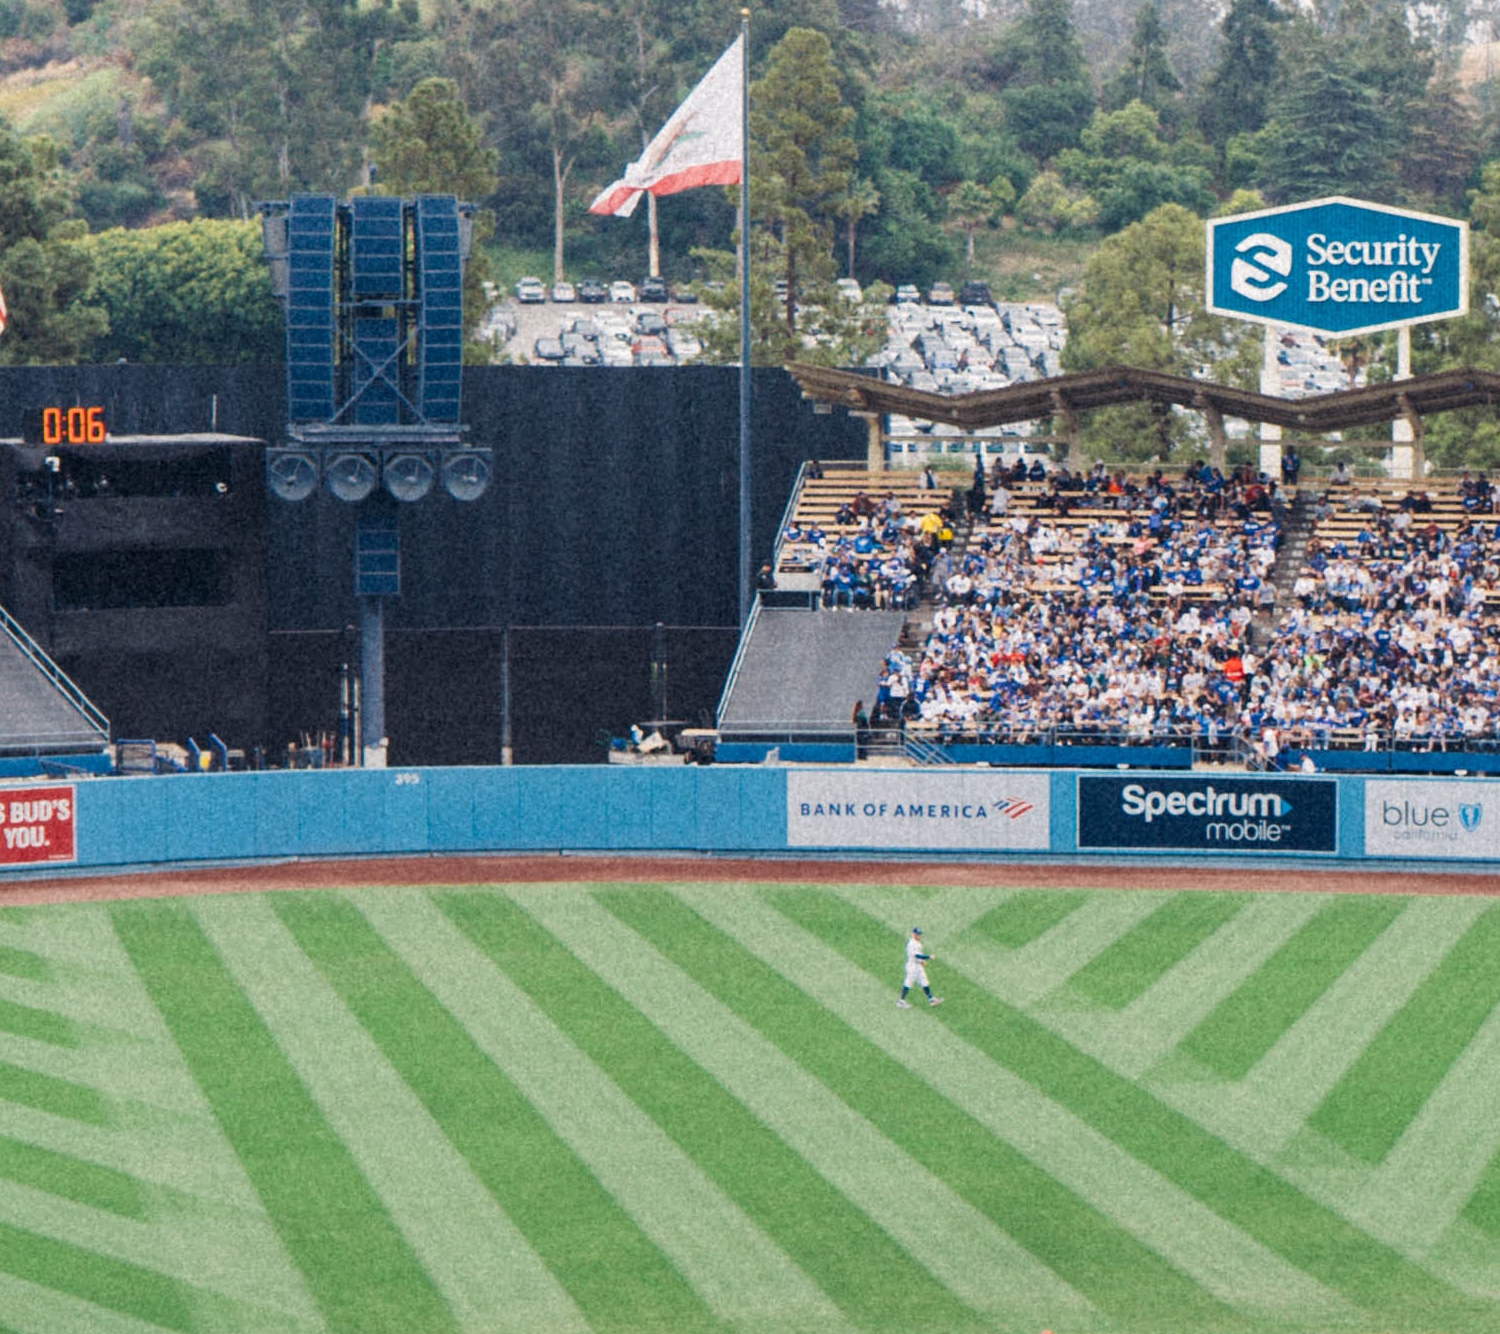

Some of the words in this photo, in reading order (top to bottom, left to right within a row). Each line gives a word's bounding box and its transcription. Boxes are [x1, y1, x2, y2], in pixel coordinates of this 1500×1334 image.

[1306, 233, 1441, 273] Security
[1307, 271, 1421, 303] Benefit
[43, 407, 105, 444] 0:06
[10, 798, 71, 824] BUD'S
[799, 802, 857, 819] BANK
[863, 802, 888, 819] OF
[892, 803, 988, 820] AMERICA
[1122, 784, 1281, 823] Spectrum
[1383, 801, 1449, 826] blue
[3, 826, 50, 849] YOU.
[1207, 819, 1282, 842] mobile
